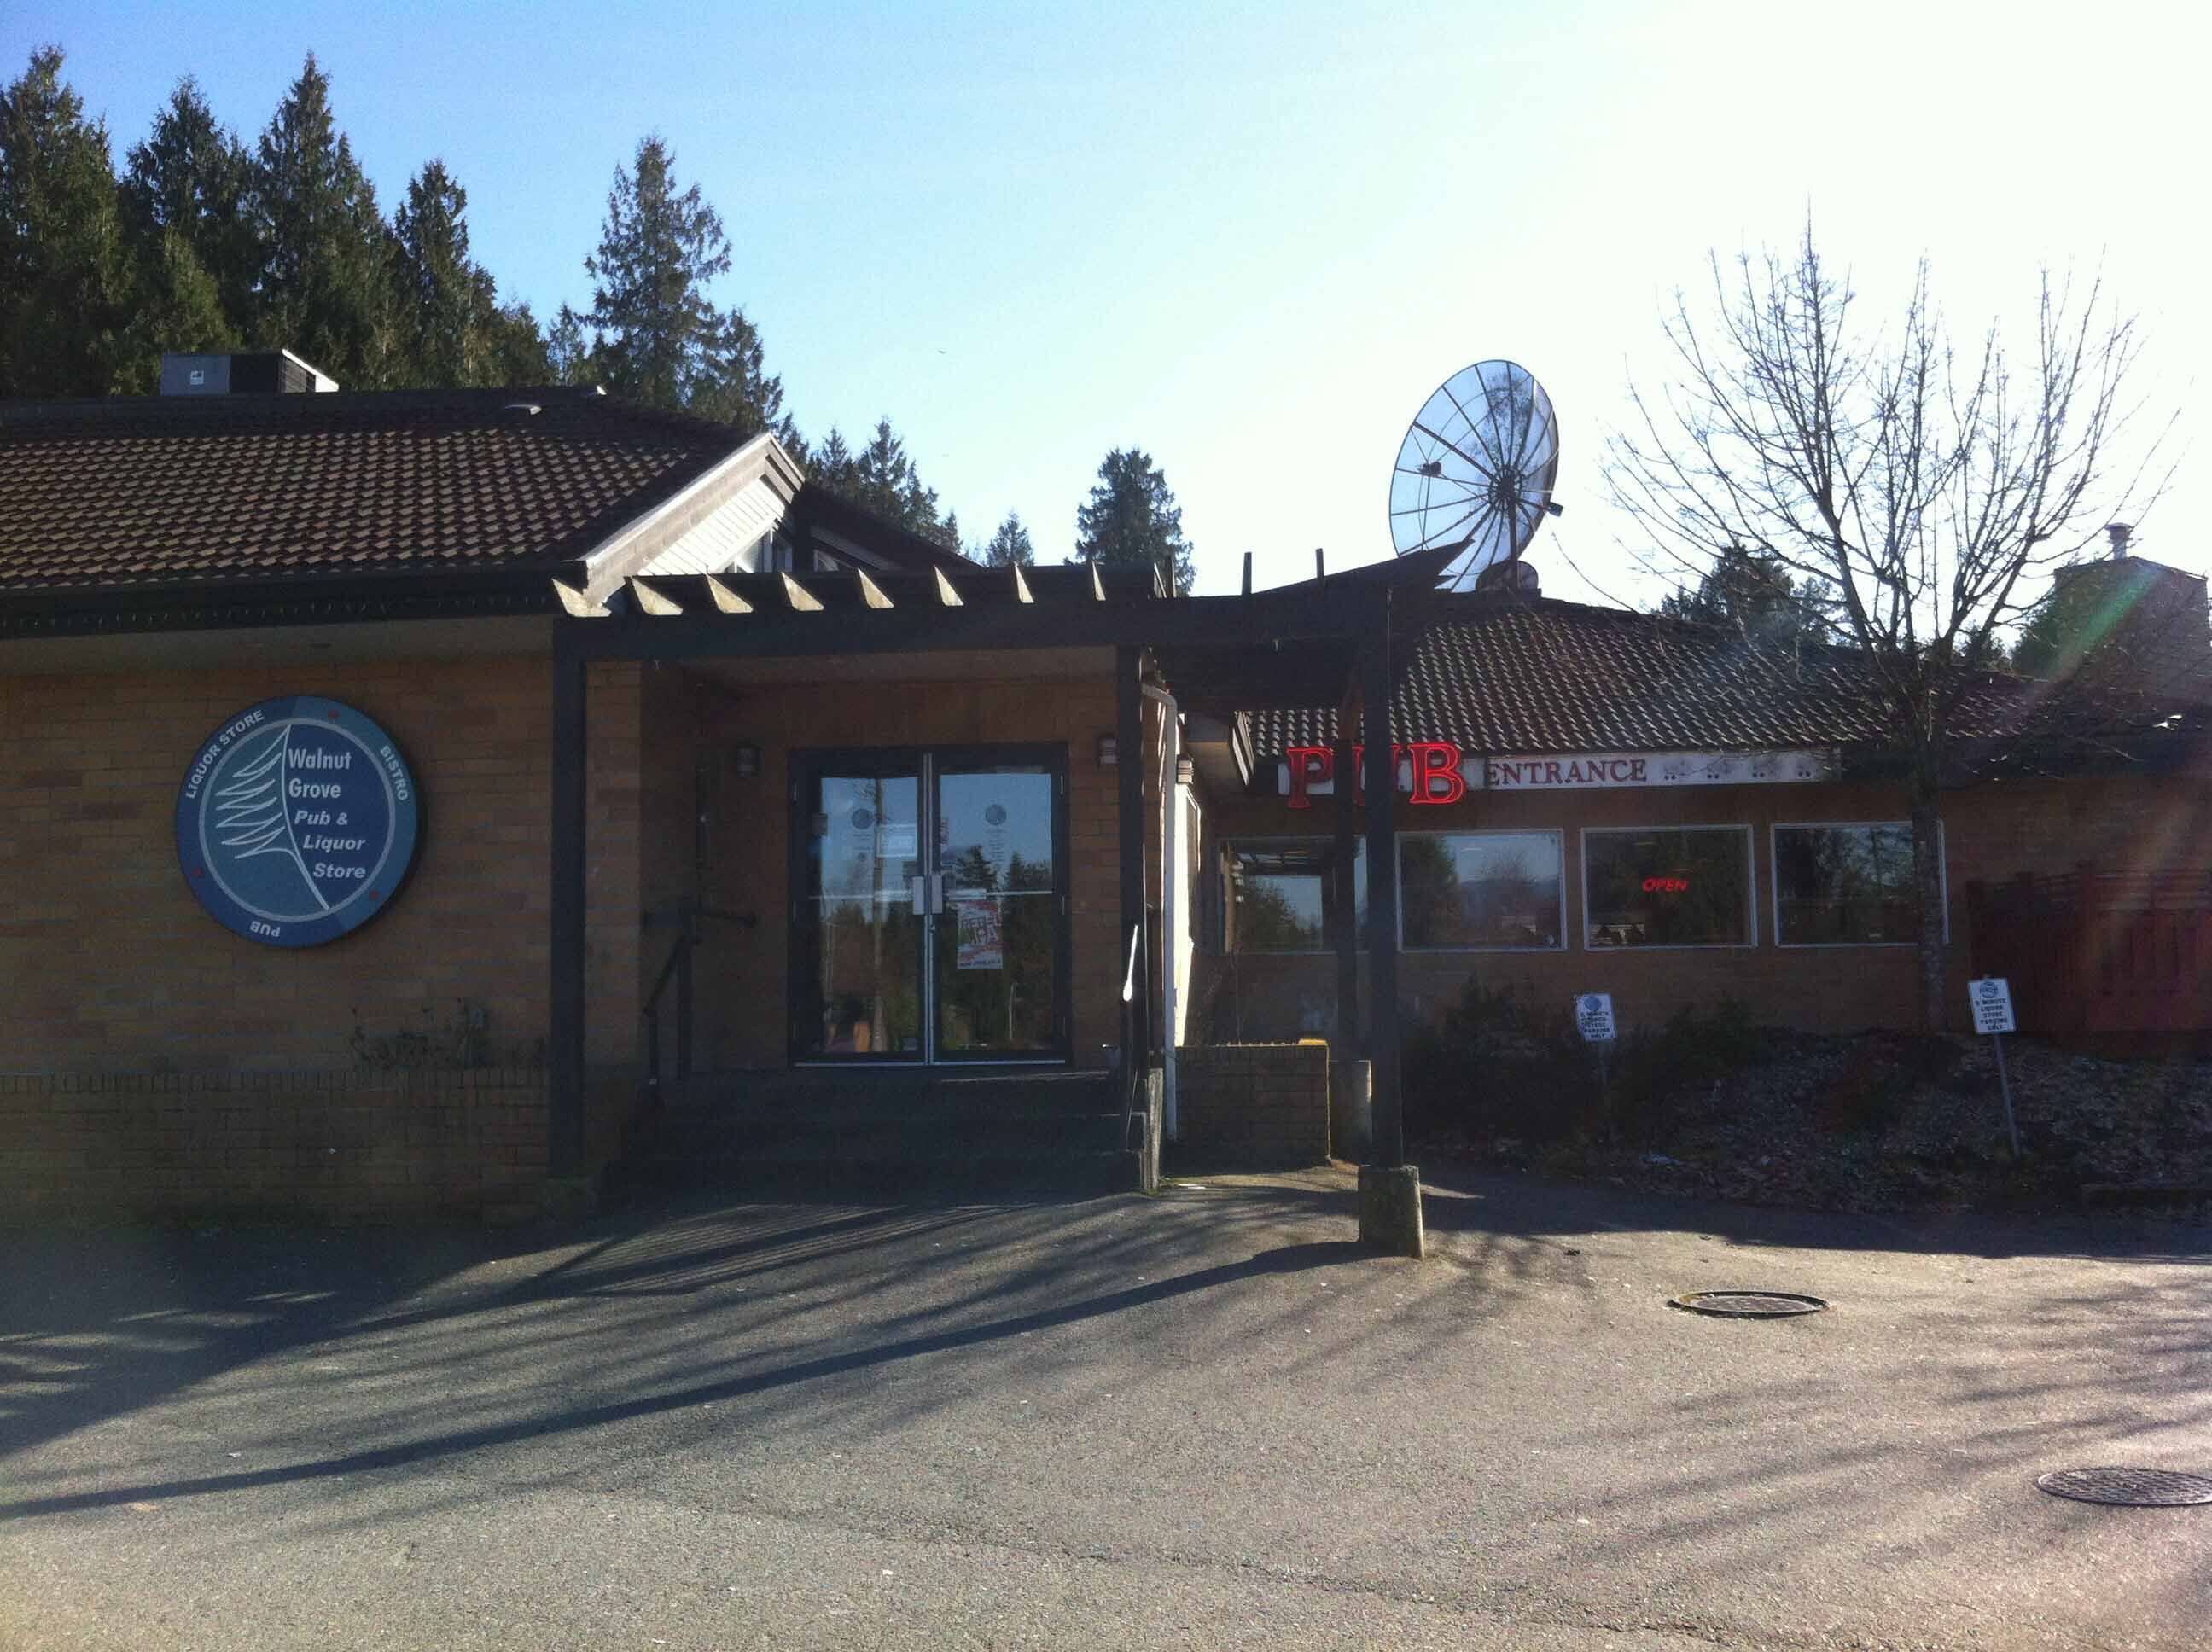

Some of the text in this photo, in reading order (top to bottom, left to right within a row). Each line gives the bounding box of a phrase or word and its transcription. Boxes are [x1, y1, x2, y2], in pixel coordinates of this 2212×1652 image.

[219, 709, 265, 746] STORE
[288, 747, 352, 770] Walnut
[380, 745, 409, 801] BISTRO
[1487, 759, 1648, 785] ENTRANCE
[288, 777, 341, 799] Grove
[294, 810, 348, 826] Pub &
[303, 834, 365, 853] Liquor
[313, 862, 366, 879] Store
[1642, 877, 1689, 893] OPEN
[249, 921, 280, 938] PUB
